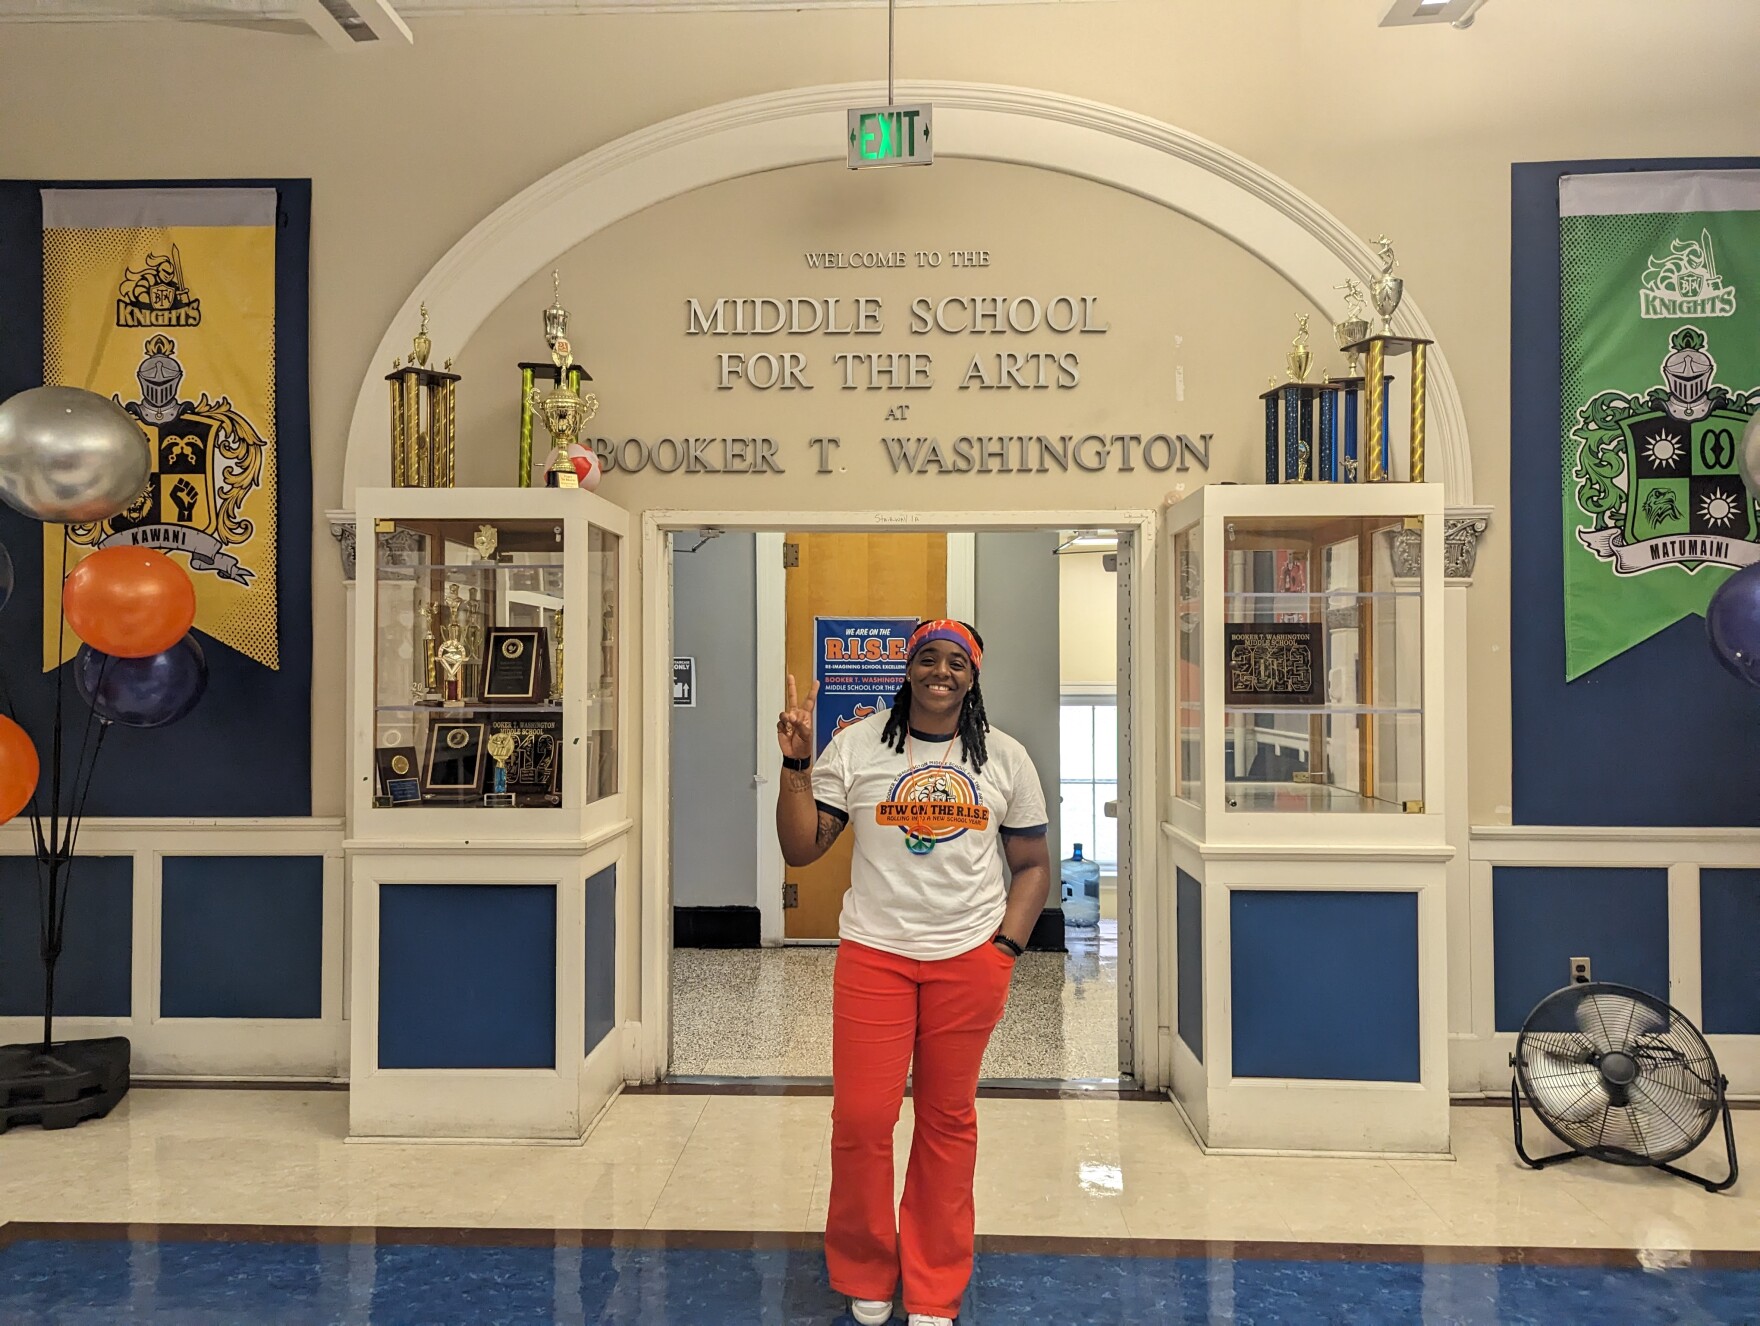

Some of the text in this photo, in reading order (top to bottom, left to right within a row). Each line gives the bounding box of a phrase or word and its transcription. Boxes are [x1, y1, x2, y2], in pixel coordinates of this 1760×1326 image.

[859, 110, 920, 160] EXIT
[805, 250, 991, 268] WELCOME TO THE
[117, 299, 201, 327] KNIGHTS
[685, 295, 1111, 335] MIDDLE SCHOOL
[1641, 287, 1736, 317] KNIGHTS
[717, 351, 1081, 389] FOR THE ARTS
[885, 404, 910, 421] AT
[587, 437, 785, 474] BOOKER
[881, 433, 1214, 475] WASHINGTON
[131, 528, 186, 546] KAWANI
[1649, 539, 1729, 560] MATUMAINI
[825, 638, 908, 662] R.I.S.E.
[880, 804, 989, 821] BTW ON THE R.I.S.E.
